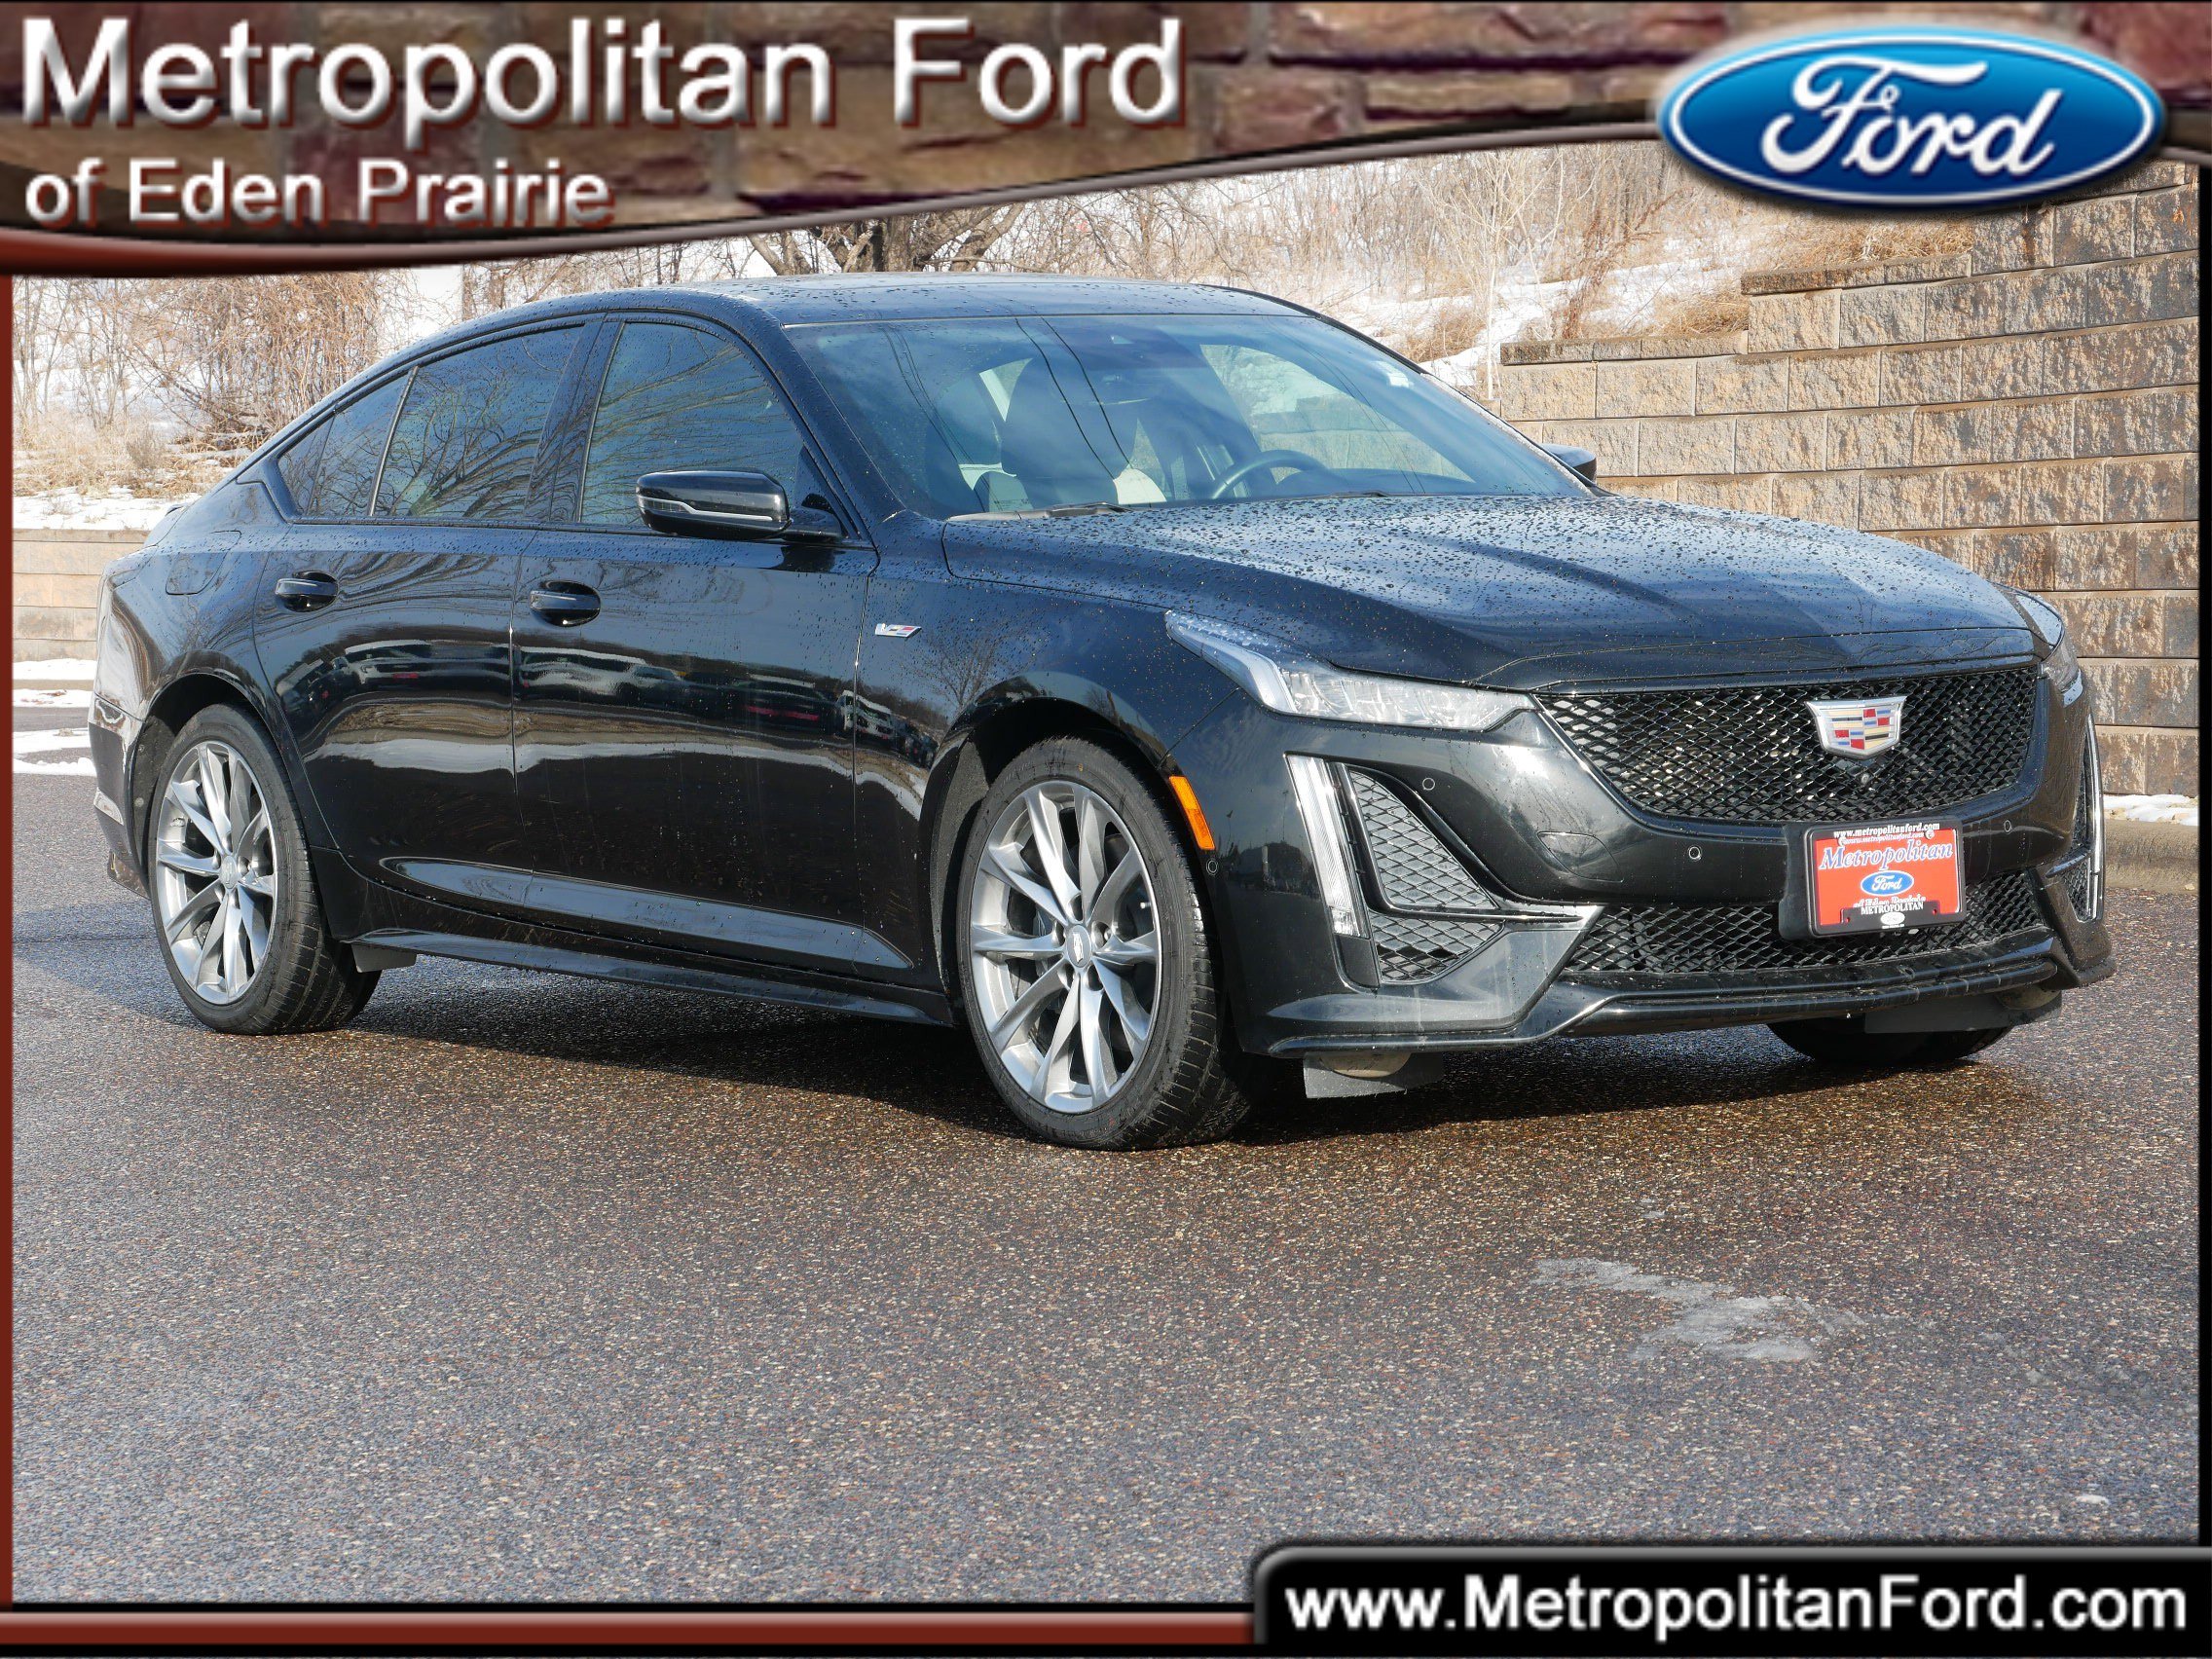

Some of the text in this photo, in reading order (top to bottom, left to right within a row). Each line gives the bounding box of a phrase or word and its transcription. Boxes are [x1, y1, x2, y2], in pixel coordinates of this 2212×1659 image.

[1833, 823, 1940, 839] www.metropolitanford.com
[1819, 838, 1953, 870] Metropolitan
[1871, 874, 1902, 891] Ford
[1861, 902, 1924, 915] METROPOLITAN
